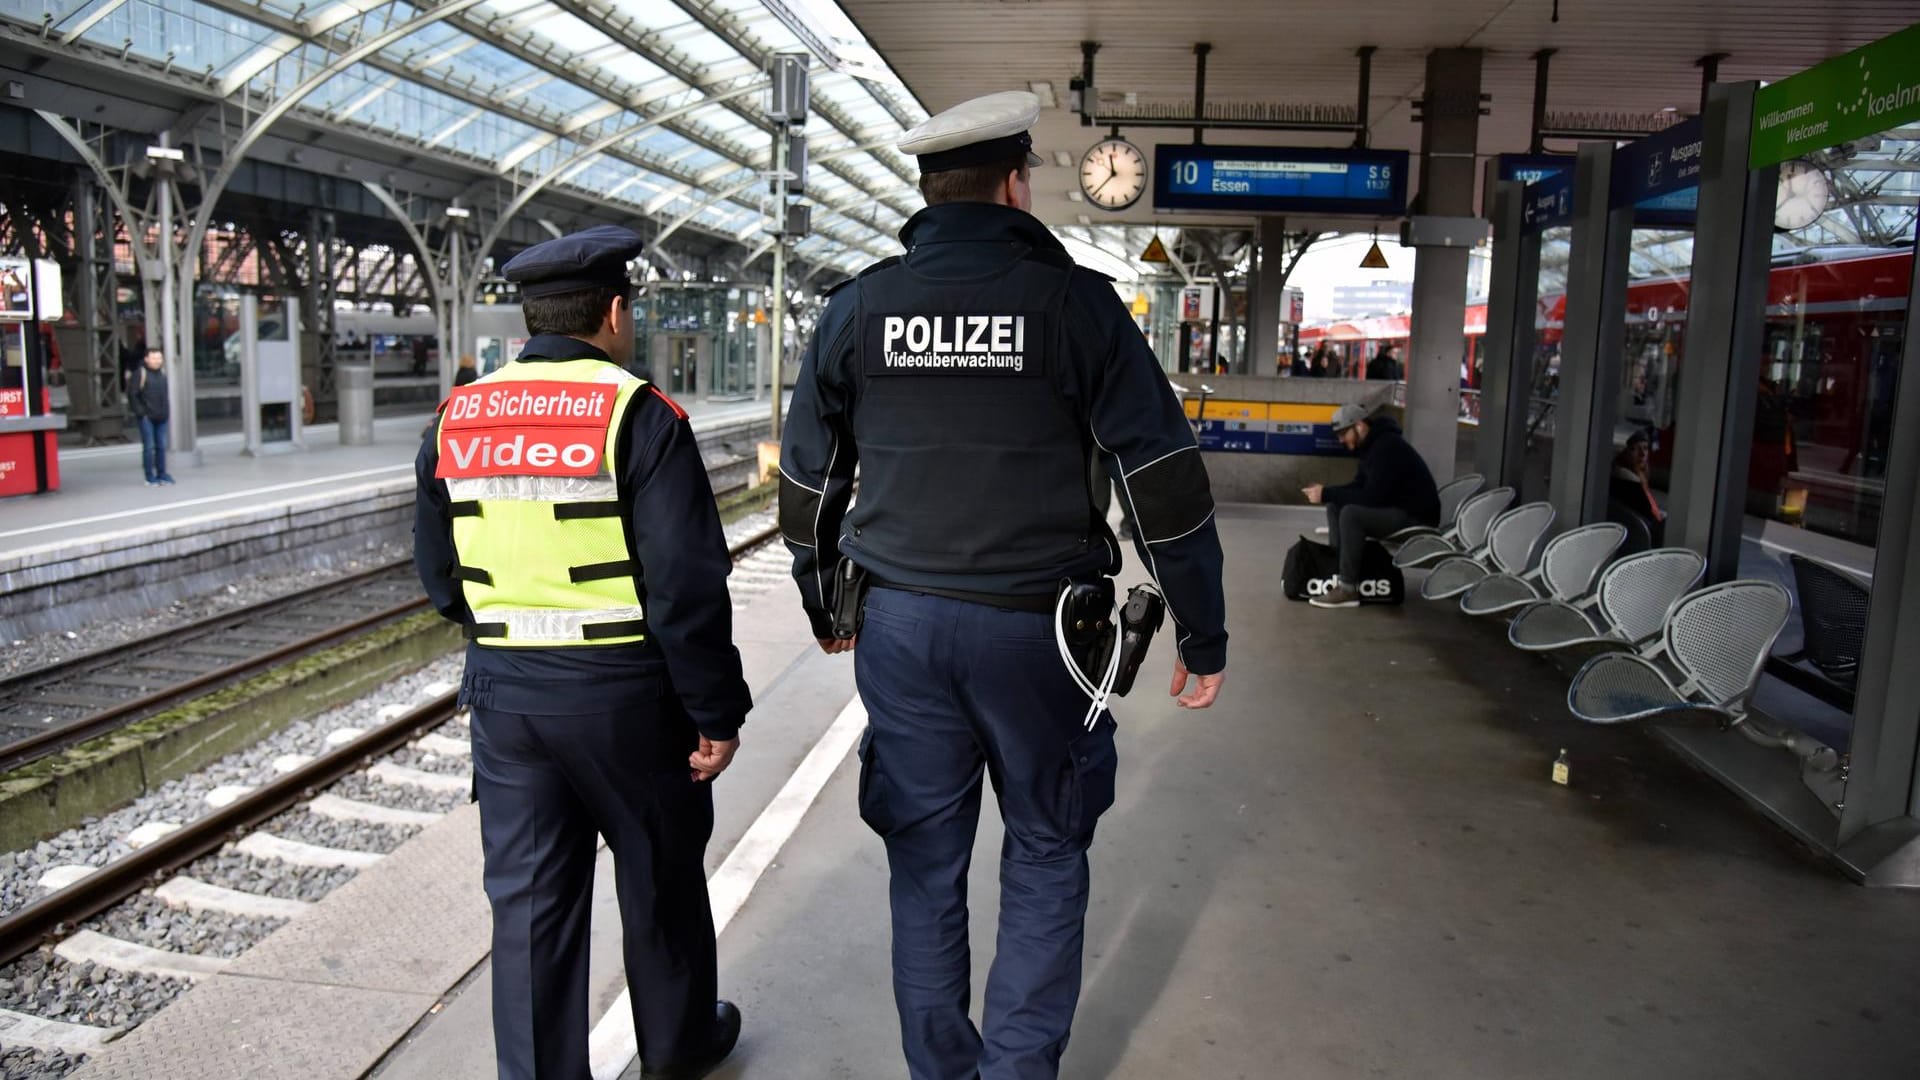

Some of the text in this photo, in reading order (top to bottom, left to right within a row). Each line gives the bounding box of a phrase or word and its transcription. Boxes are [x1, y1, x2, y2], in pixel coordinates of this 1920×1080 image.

[1759, 101, 1814, 130] Willkommen
[1786, 120, 1829, 144] Welcome
[1669, 140, 1702, 163] Ausgang
[1171, 159, 1199, 185] 10
[1369, 165, 1391, 179] S 6
[1212, 178, 1249, 192] Essen
[1366, 179, 1390, 190] 11:37
[883, 315, 1025, 353] POLIZEI
[884, 351, 1024, 371] Videoüberwachung
[450, 389, 605, 421] DB Sicherheit
[447, 434, 596, 470] Video
[1306, 574, 1391, 597] adas
